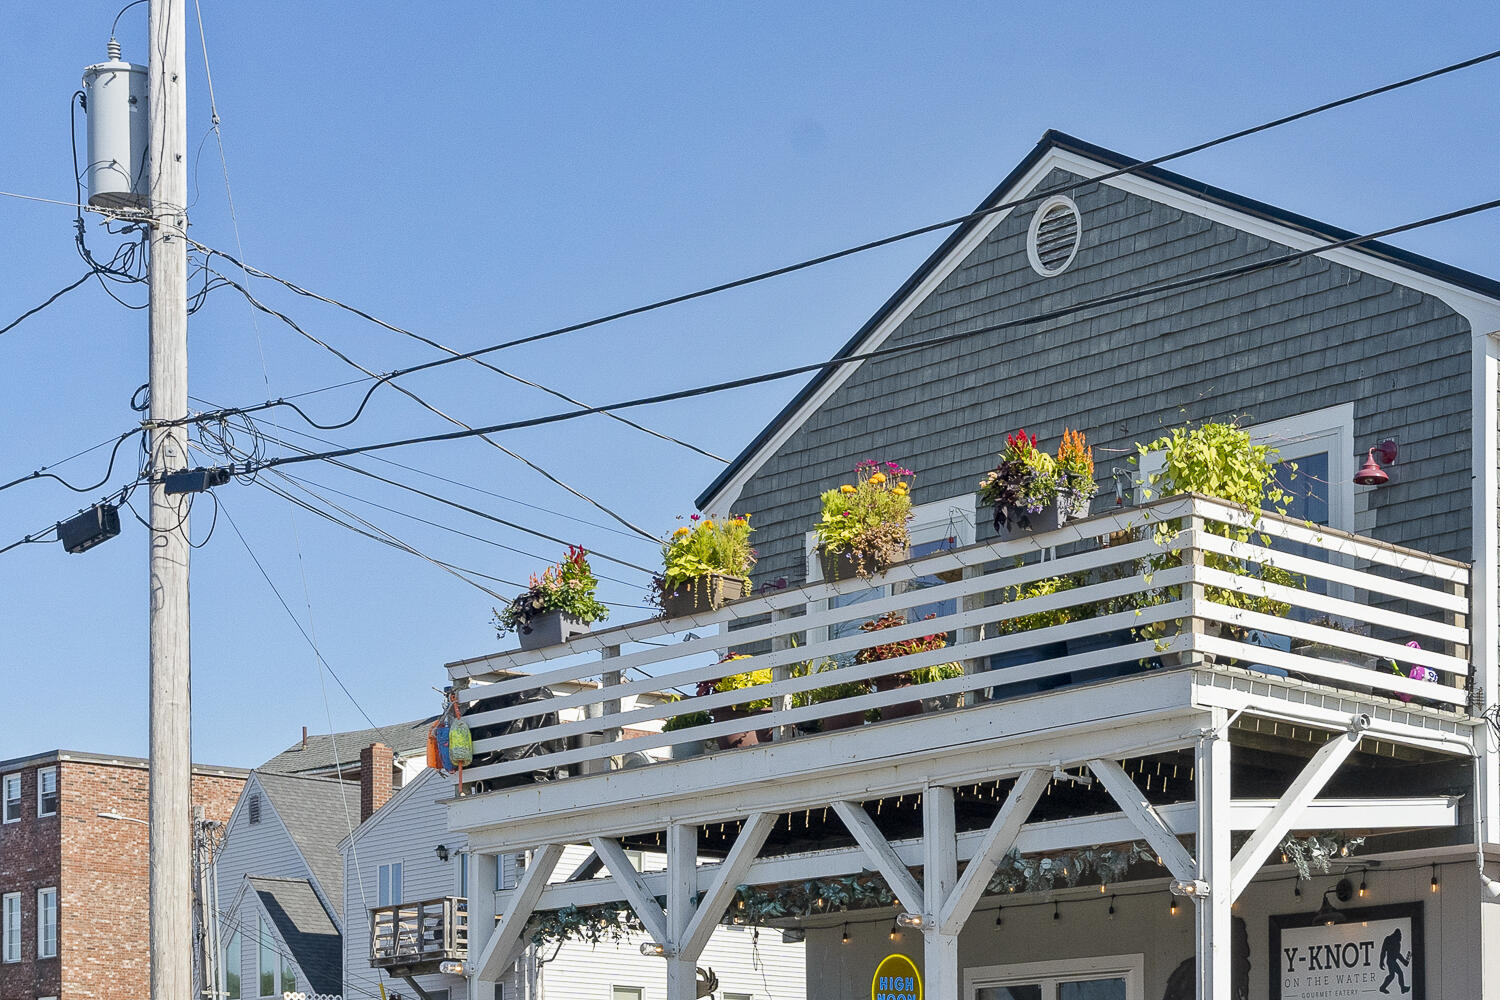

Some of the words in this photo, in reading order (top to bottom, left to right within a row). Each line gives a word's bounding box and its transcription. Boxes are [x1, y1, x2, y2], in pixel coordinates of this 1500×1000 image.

[1284, 941, 1375, 972] Y-KNOT
[879, 976, 914, 992] HIGH
[1284, 978, 1300, 989] ON
[1306, 975, 1330, 987] THE
[1336, 973, 1377, 984] WATER
[1301, 990, 1332, 999] GOURMET
[1335, 989, 1359, 997] EATERY
